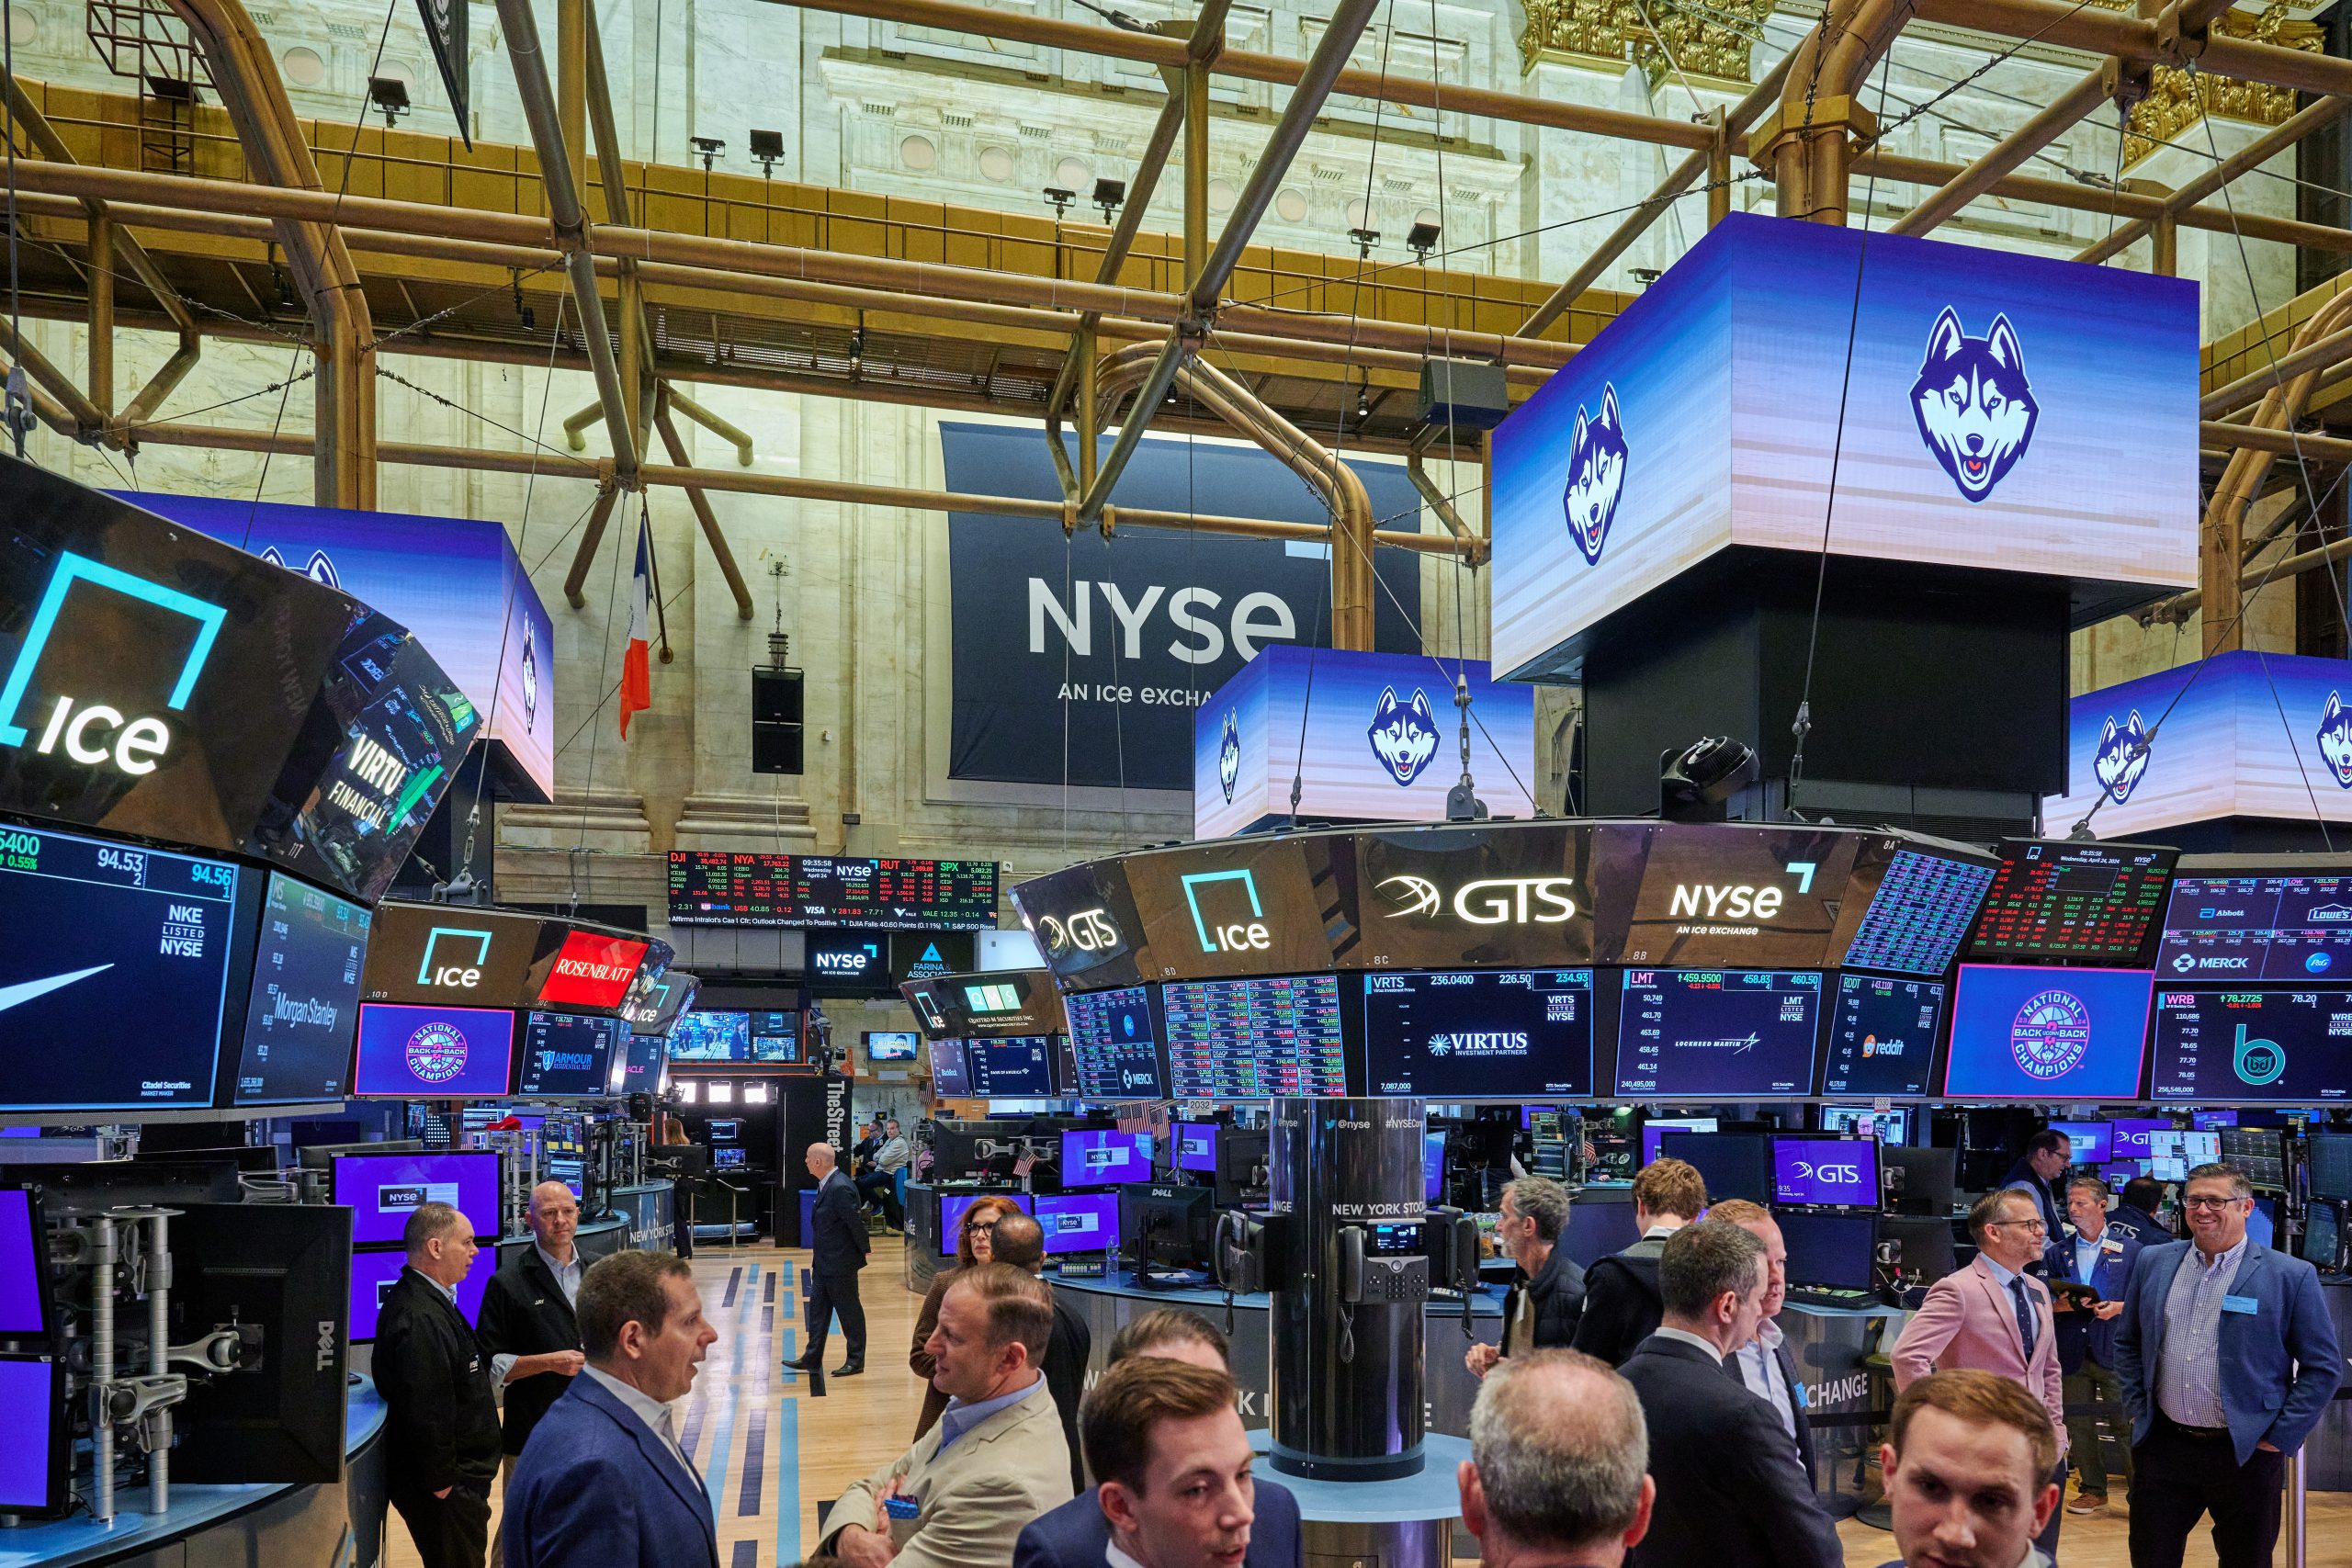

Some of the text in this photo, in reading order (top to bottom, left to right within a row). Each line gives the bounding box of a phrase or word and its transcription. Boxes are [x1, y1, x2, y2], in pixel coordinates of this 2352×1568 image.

[1057, 682, 1088, 701] AN
[347, 733, 406, 795] VIRTU
[328, 781, 388, 829] FINANCIAL
[1883, 840, 1894, 850] 8A
[97, 848, 143, 873] 94.53
[191, 863, 232, 886] 94.56
[670, 852, 959, 872] DJI NYA RUT SPX
[7, 854, 230, 898] 0.55% 2 1
[1454, 877, 1576, 924] GTS
[169, 904, 203, 924] NKE
[804, 906, 825, 914] VISA
[776, 919, 805, 927] Changed
[1068, 908, 1117, 951] GTS
[1676, 926, 1690, 934] AN
[163, 926, 205, 939] LISTED
[160, 939, 203, 957] NYSE
[1633, 951, 1646, 960] 8B
[2199, 957, 2248, 968] MERCK
[555, 958, 632, 982] ROSENBLATT
[913, 963, 944, 971] FARINA
[1373, 973, 1589, 988] VRTS 236.0400 226.50 234.93
[1631, 972, 1818, 985] LMT 459.9500 458.83 460.50
[1843, 978, 1861, 989] RDDT
[1547, 996, 1575, 1004] VRTS
[2166, 994, 2317, 1004] WRB 78.2725 78.20
[275, 992, 337, 1032] Morgan Stanley
[2023, 994, 2082, 1019] NATIONAL
[1547, 1012, 1575, 1021] NYSE
[1780, 1013, 1803, 1021] NYSE
[1917, 1021, 1930, 1029] NYSE
[414, 1024, 459, 1042] NATIONAL
[2014, 1028, 2042, 1037] BACK
[2059, 1029, 2086, 1038] BACK
[1450, 1032, 1528, 1050] VIRTUS
[1875, 1040, 1905, 1055] reddit
[553, 1053, 593, 1065] ARMOUR
[2015, 1043, 2083, 1077] CHAMPIONS
[410, 1057, 463, 1081] CHAMPIONS
[141, 1081, 191, 1090] Citadel Securities
[1133, 1074, 1153, 1085] MERCK
[1621, 1080, 1656, 1089] 240,495,000
[1190, 1100, 1210, 1109] 2032
[827, 1081, 845, 1153] TheStreet
[1278, 1119, 1298, 1128] @nyse
[1338, 1120, 1370, 1131] @nyse
[2132, 1133, 2150, 1145] GT
[1152, 1189, 1172, 1197] DELL
[1272, 1201, 1292, 1213] ANGE
[1332, 1204, 1363, 1215] NEW
[1367, 1203, 1400, 1215] YORK
[629, 1226, 665, 1243] NEW YORK
[2109, 1221, 2141, 1239] GTS
[317, 1321, 334, 1371] DELL
[1806, 1372, 1868, 1408] CHANGE
